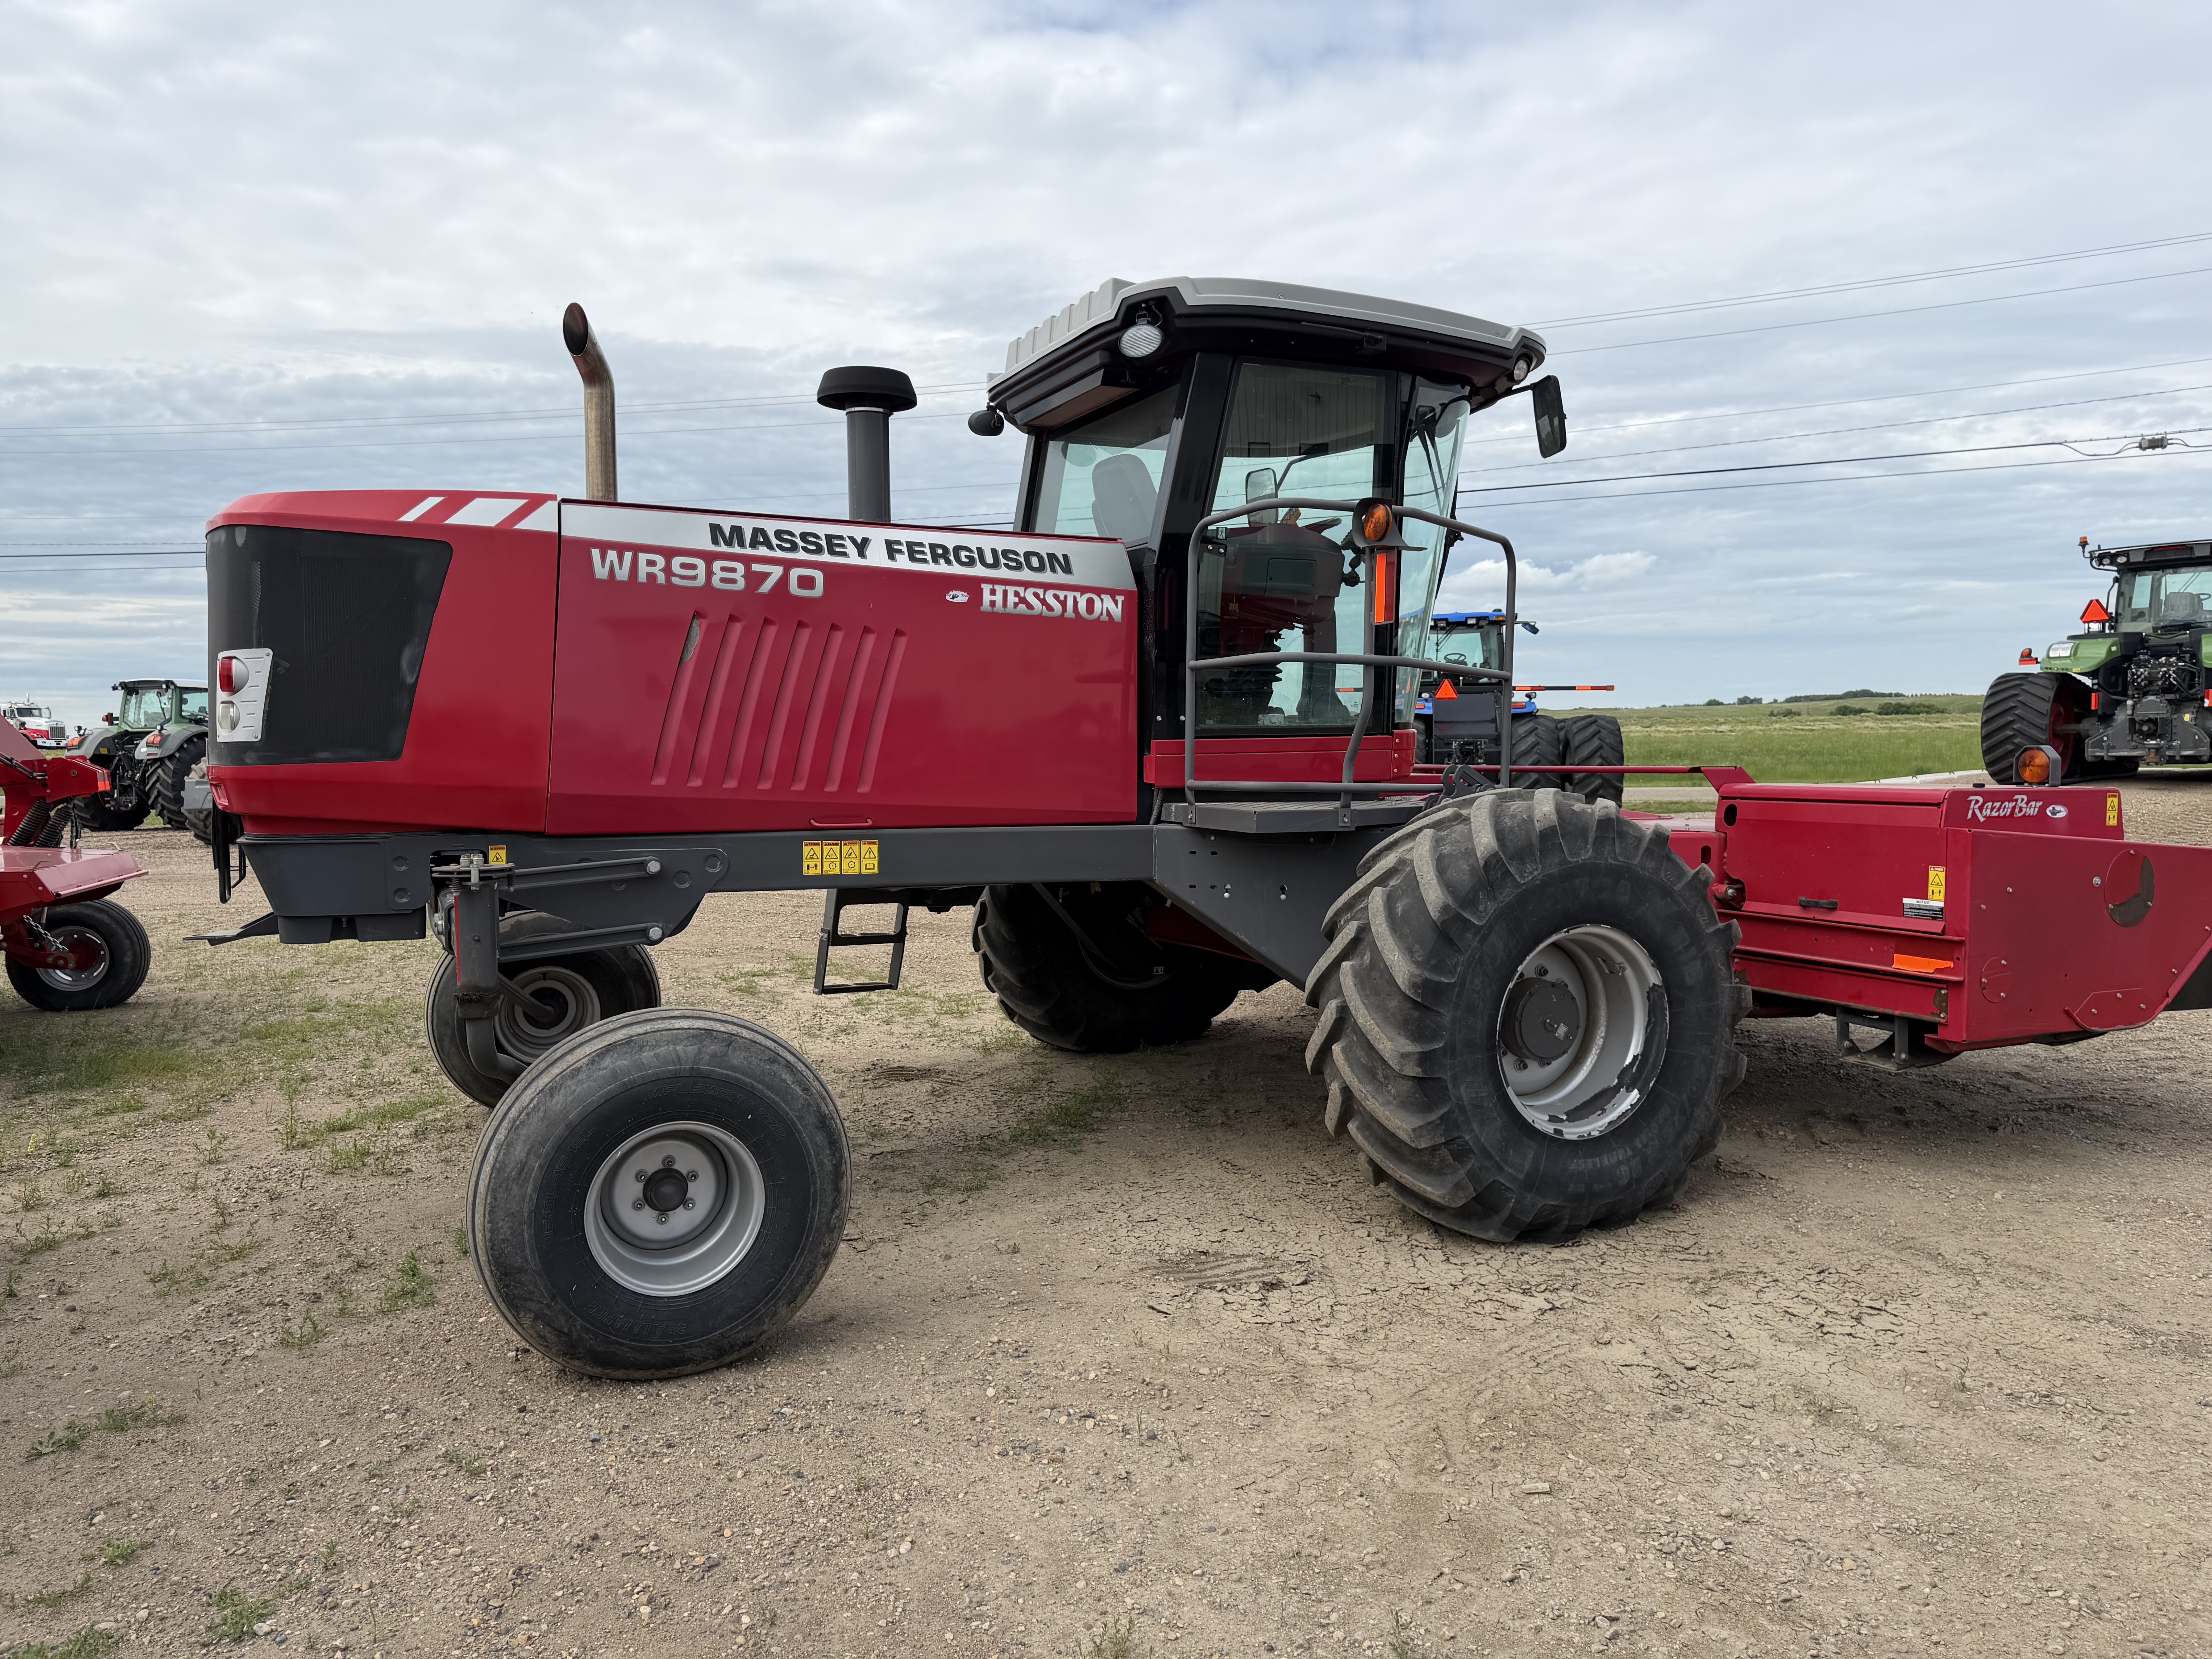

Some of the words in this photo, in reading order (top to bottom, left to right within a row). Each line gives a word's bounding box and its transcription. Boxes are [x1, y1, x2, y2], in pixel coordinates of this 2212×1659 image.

[590, 547, 824, 598] WR9870
[709, 523, 872, 559] MASSEY
[884, 539, 1075, 575] FERGUSON
[981, 584, 1125, 623] HESSTON
[642, 1084, 754, 1108] IMPLEMENT
[756, 1108, 785, 1139] 222
[584, 1301, 666, 1339] ALLIANCE
